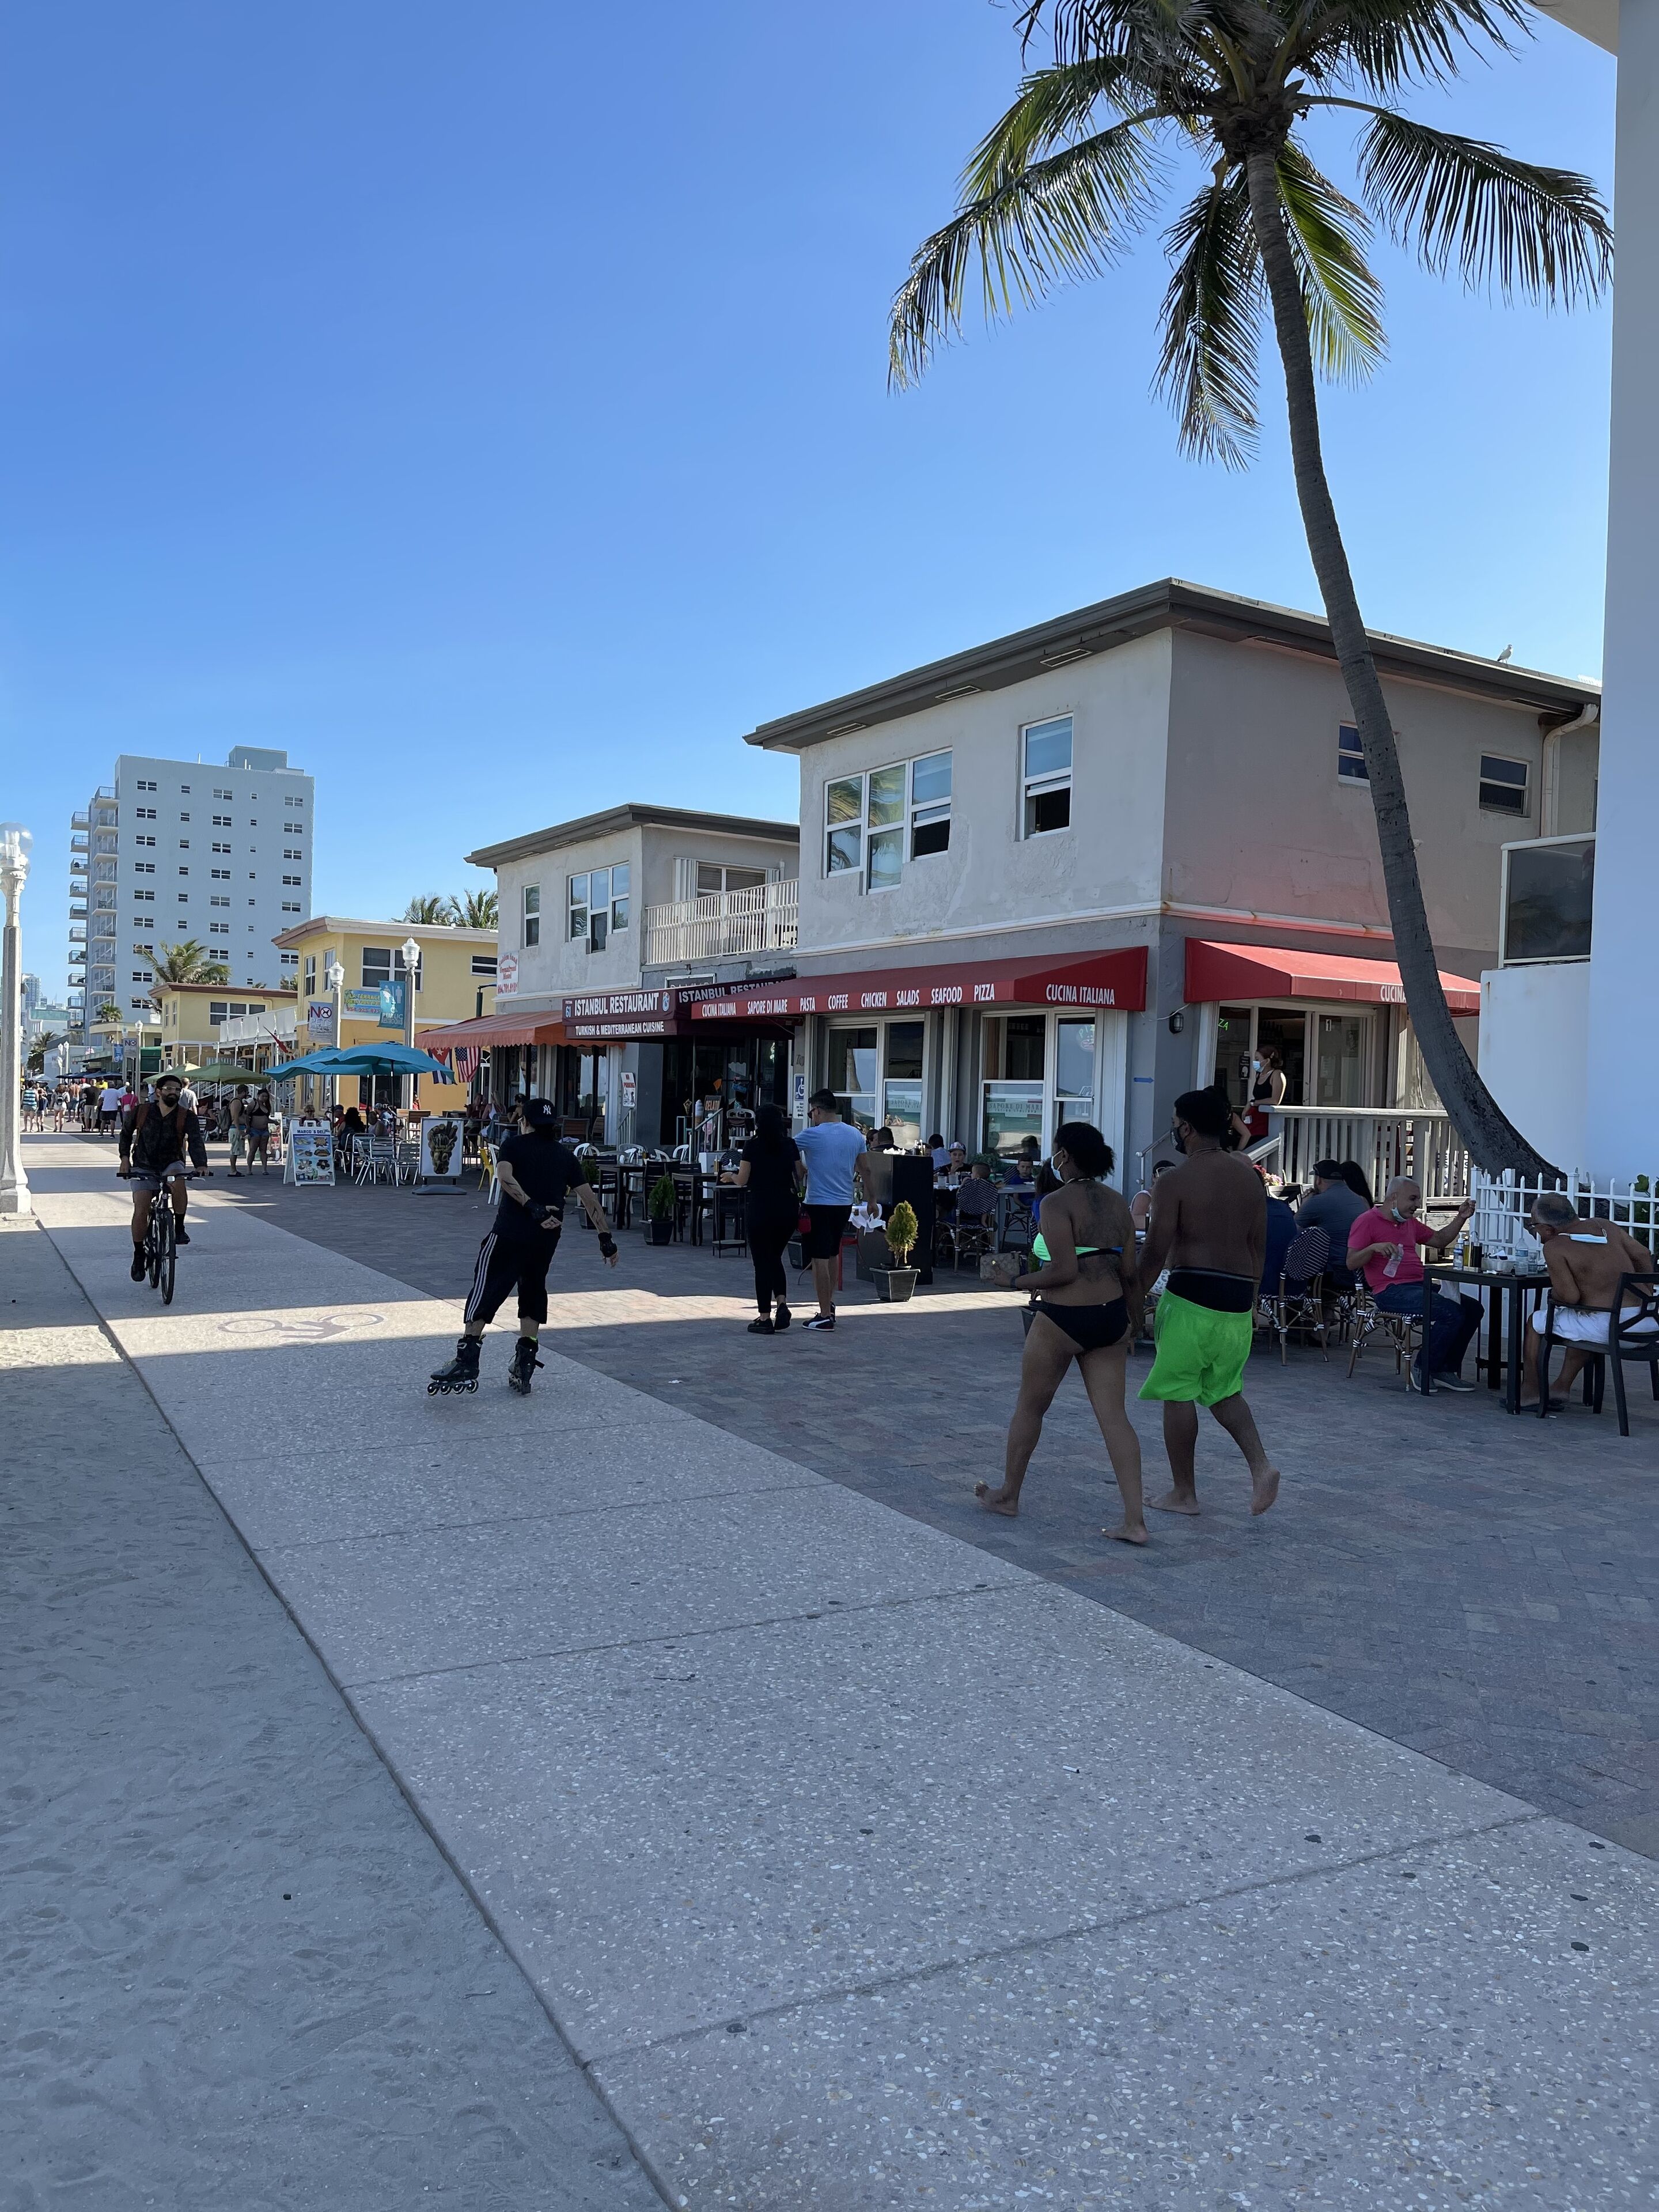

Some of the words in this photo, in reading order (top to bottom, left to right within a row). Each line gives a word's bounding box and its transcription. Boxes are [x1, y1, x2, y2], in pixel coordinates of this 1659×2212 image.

[679, 987, 728, 1003] ISTANBUL
[702, 1003, 717, 1017] CUCINA
[718, 1002, 736, 1016] ITALIANA
[747, 1000, 766, 1014] SAPORE
[767, 999, 772, 1014] DI
[773, 999, 787, 1013] MARE
[800, 997, 815, 1012] PASTA
[828, 994, 849, 1010] COFFEE
[861, 991, 887, 1007] CHICKEN
[896, 989, 919, 1006] SALADS
[931, 986, 963, 1005] SEAFOOD
[974, 983, 995, 1001] PIZZA
[1046, 984, 1077, 1003] CUCINA
[1079, 986, 1115, 1005] ITALIANA
[310, 1006, 332, 1018] NO
[574, 997, 608, 1016] ISTANBUL
[609, 993, 660, 1014] RESTAURANT
[310, 1017, 332, 1026] PETS
[575, 1025, 596, 1036] TURKISH
[596, 1025, 600, 1035] &
[601, 1022, 642, 1035] MEDITERRANEAN
[642, 1021, 664, 1033] CUISINE
[543, 1105, 551, 1115] NY
